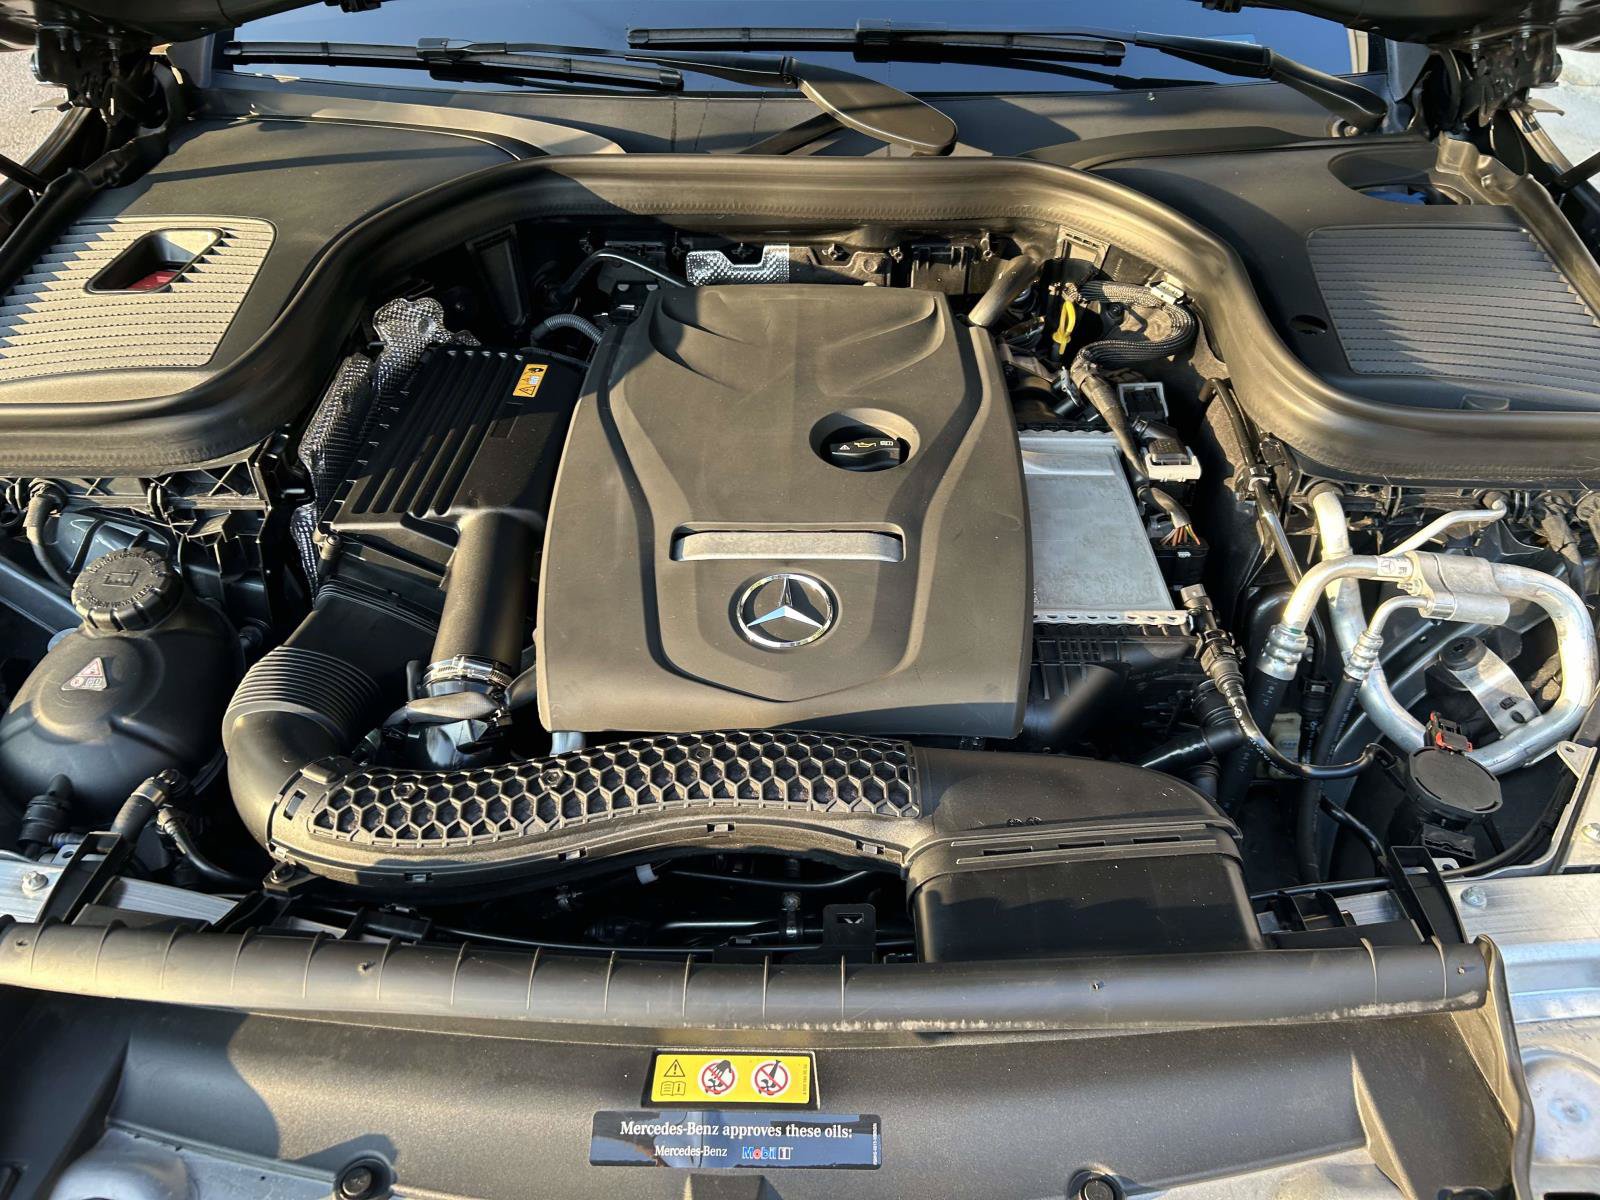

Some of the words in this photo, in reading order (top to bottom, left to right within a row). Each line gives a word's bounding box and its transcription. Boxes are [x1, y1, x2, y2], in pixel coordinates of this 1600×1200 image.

[620, 1121, 719, 1135] Mercedes-Benz
[722, 1124, 782, 1139] approves
[785, 1123, 821, 1138] these
[824, 1124, 853, 1138] oils:
[654, 1145, 728, 1157] Mercedes-Benz
[741, 1146, 777, 1160] Mobil
